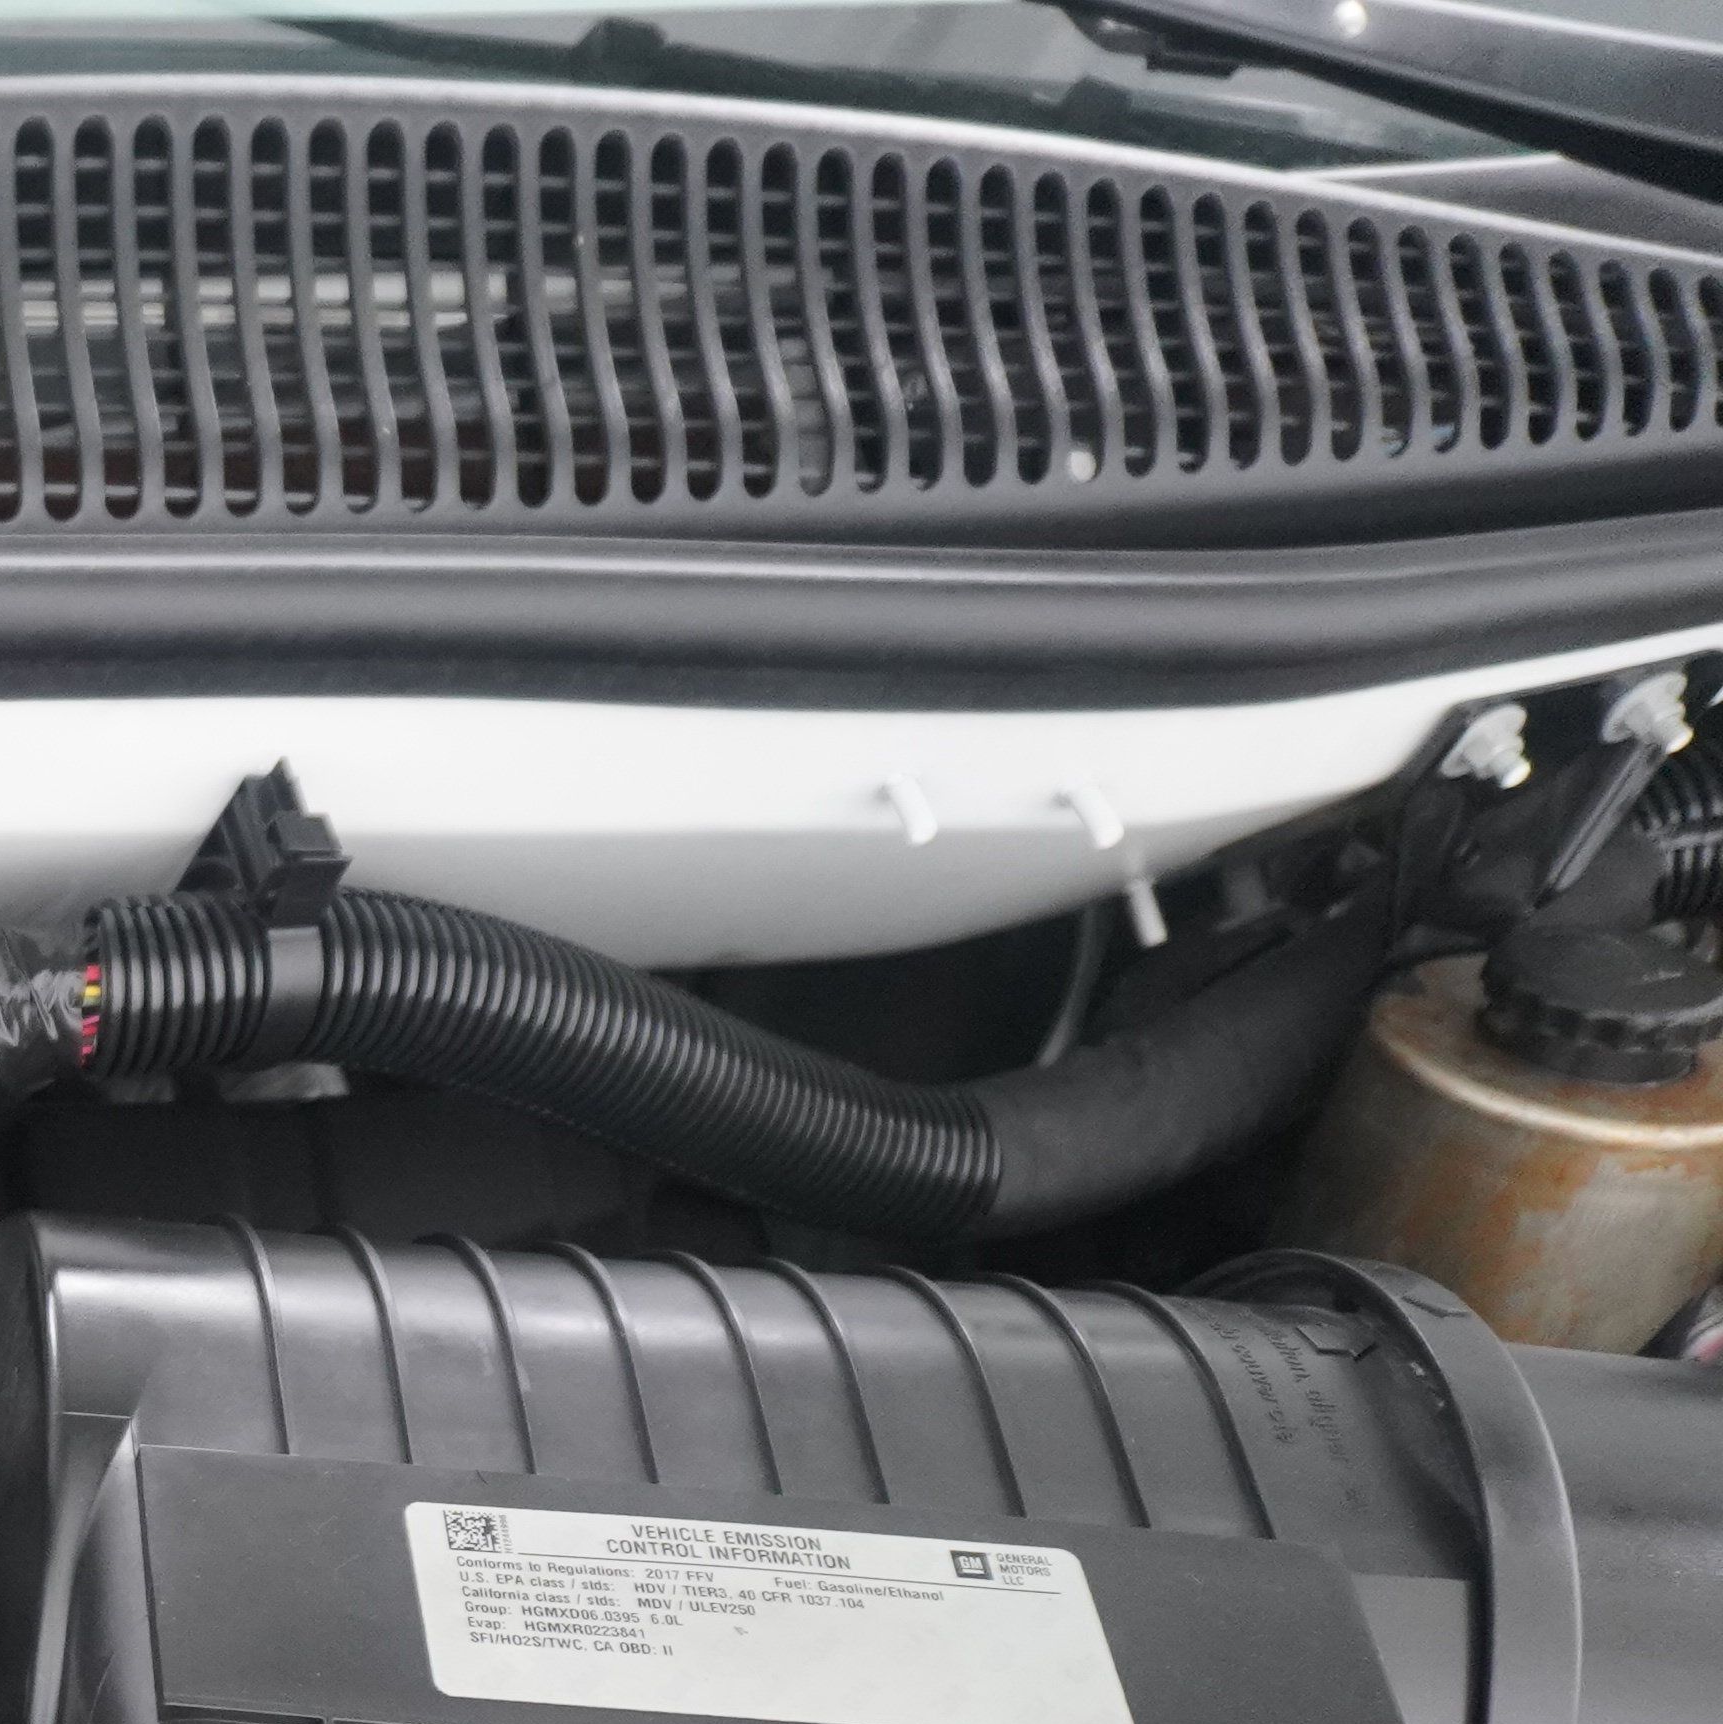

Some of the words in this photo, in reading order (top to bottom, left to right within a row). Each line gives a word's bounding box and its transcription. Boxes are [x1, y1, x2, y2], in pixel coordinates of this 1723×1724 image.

[630, 1524, 715, 1544] VEHICLE
[723, 1531, 822, 1551] EMISSION
[605, 1538, 702, 1559] CONTROL
[709, 1546, 852, 1570] INFORMATION
[957, 1555, 984, 1570] GM
[996, 1553, 1053, 1566] GENERAL
[456, 1555, 523, 1571] Conforms
[529, 1561, 541, 1572] to
[548, 1562, 635, 1578] Regulations:
[645, 1568, 679, 1580] 2017
[686, 1571, 714, 1582] FFV
[999, 1564, 1051, 1576] MOTORS
[1003, 1575, 1025, 1586] LLC
[459, 1571, 489, 1583] U.S.
[496, 1573, 524, 1586] EPA
[530, 1576, 565, 1589] class
[634, 1583, 666, 1594] HDV
[738, 1590, 756, 1601] 40
[761, 1591, 792, 1603] CFR
[799, 1595, 865, 1610] 1037.104
[461, 1586, 530, 1602] California
[535, 1592, 571, 1604] class
[637, 1598, 672, 1610] MDV
[689, 1600, 756, 1615] ULEV250
[774, 1577, 811, 1590] Fuel:
[818, 1580, 945, 1601] Gasoline/Ethanol
[464, 1600, 512, 1616] Group:
[521, 1604, 640, 1624] HGMXD06.0395
[650, 1613, 684, 1627] 6.0L
[467, 1616, 506, 1631] Evap:
[524, 1621, 645, 1639] HGMXR0223841
[594, 1640, 613, 1652] CA
